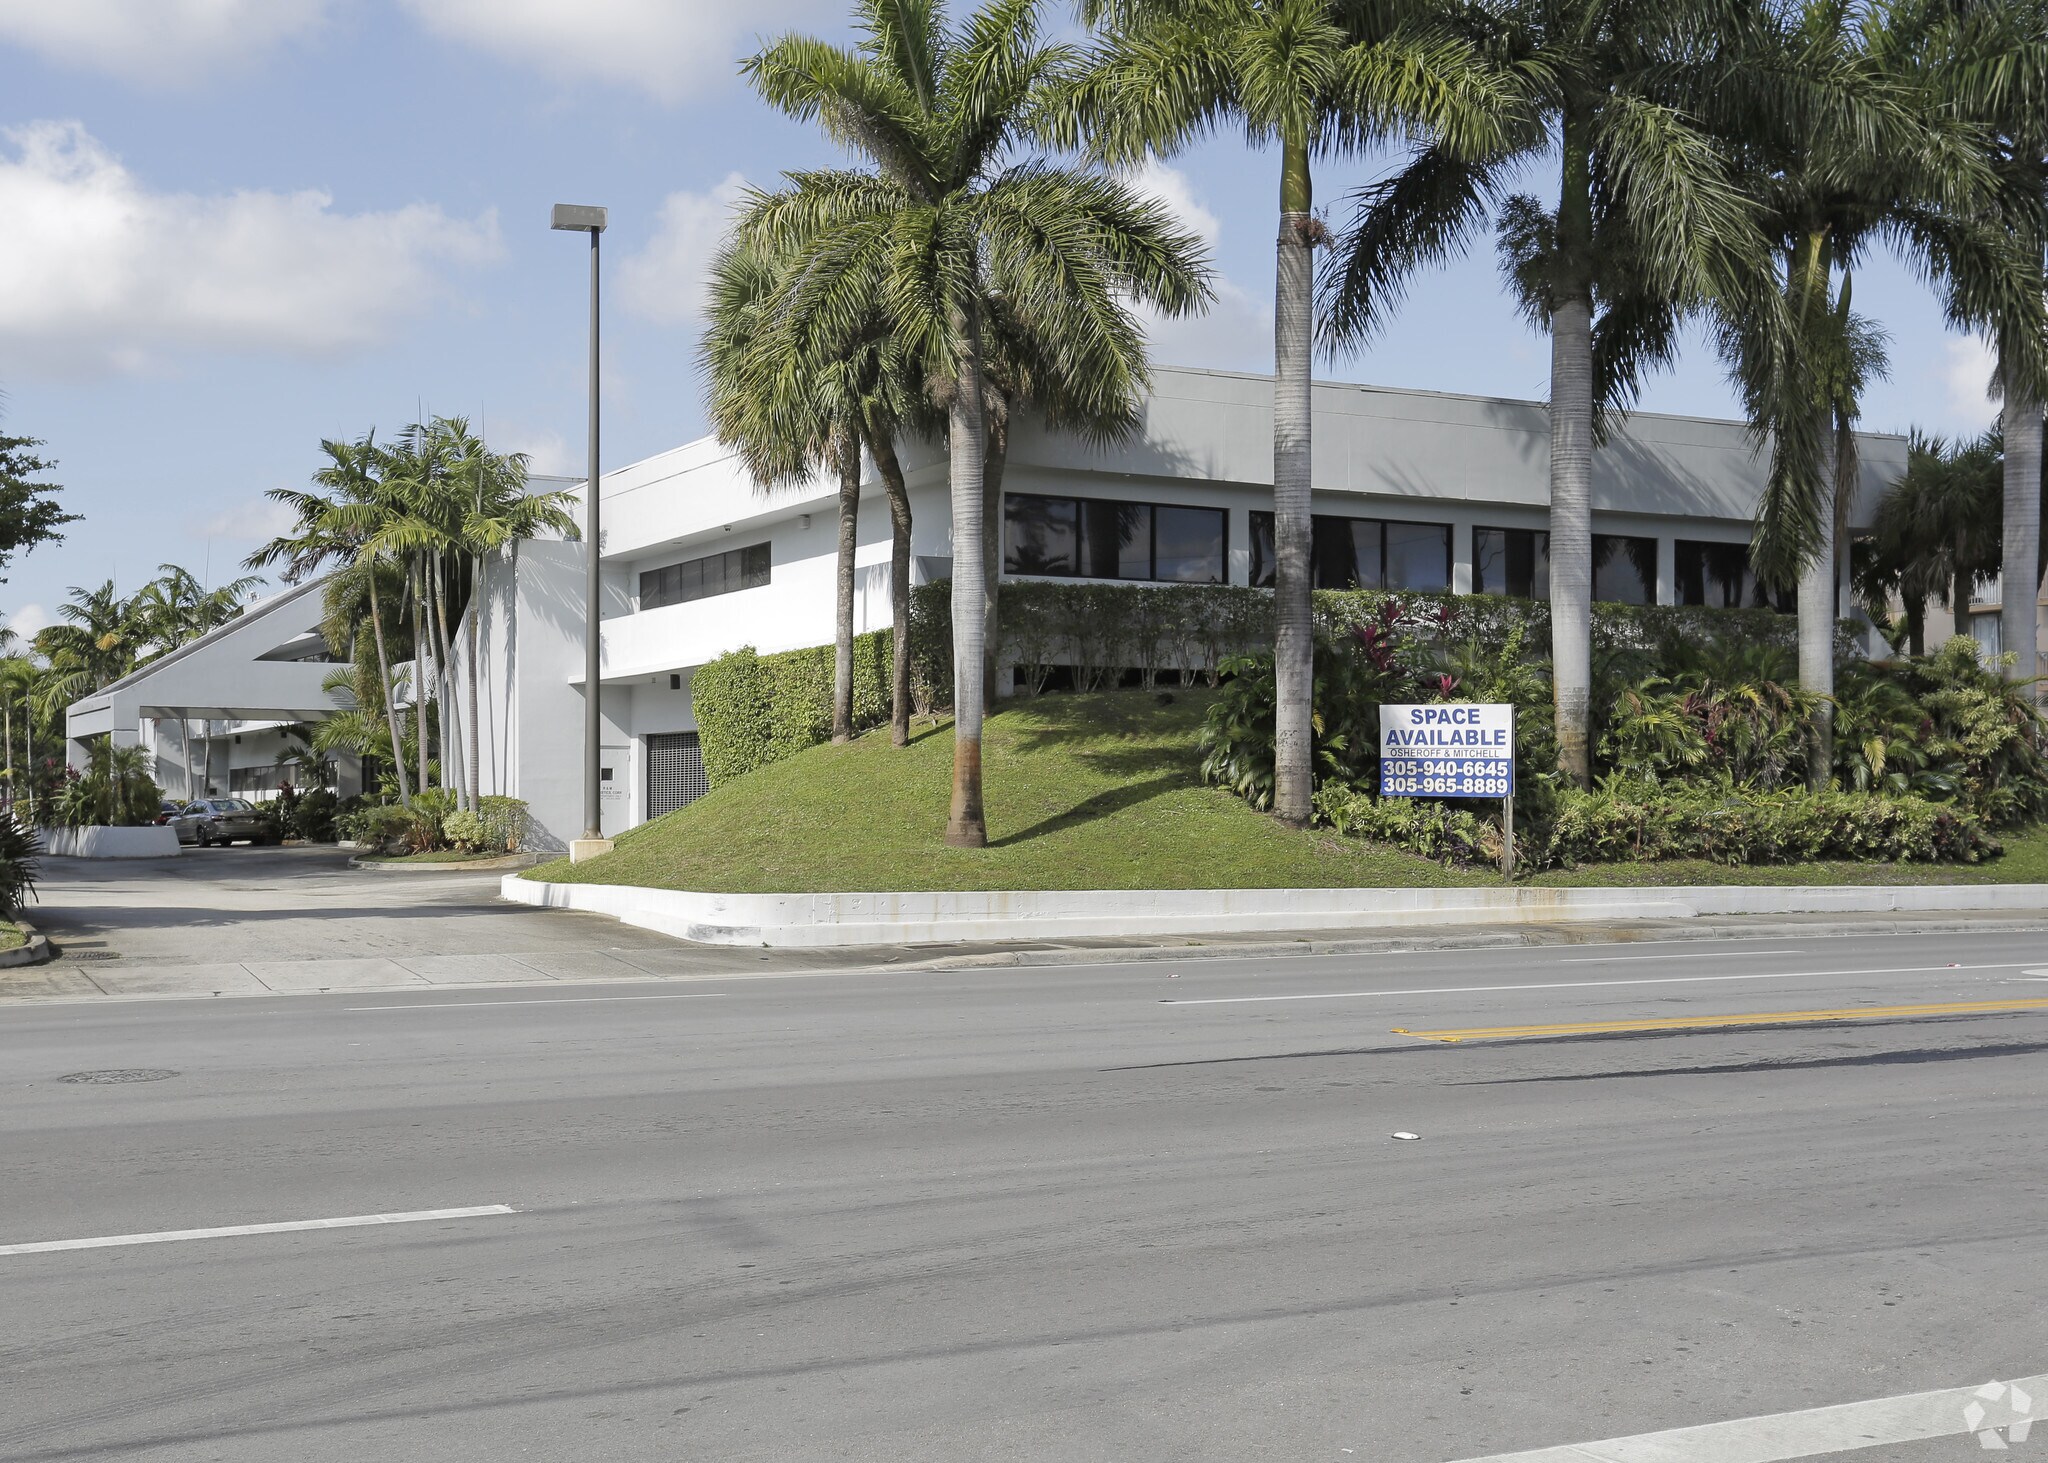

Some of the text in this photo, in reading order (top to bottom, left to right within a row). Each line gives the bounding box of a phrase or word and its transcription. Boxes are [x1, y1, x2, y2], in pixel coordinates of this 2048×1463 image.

[1411, 708, 1481, 725] SPACE
[1385, 729, 1507, 746] AVAILABLE
[1390, 749, 1500, 758] OSHEROFF & MITCHELL
[1383, 761, 1508, 777] 305-940-6645
[1383, 777, 1508, 794] 305-965-8889
